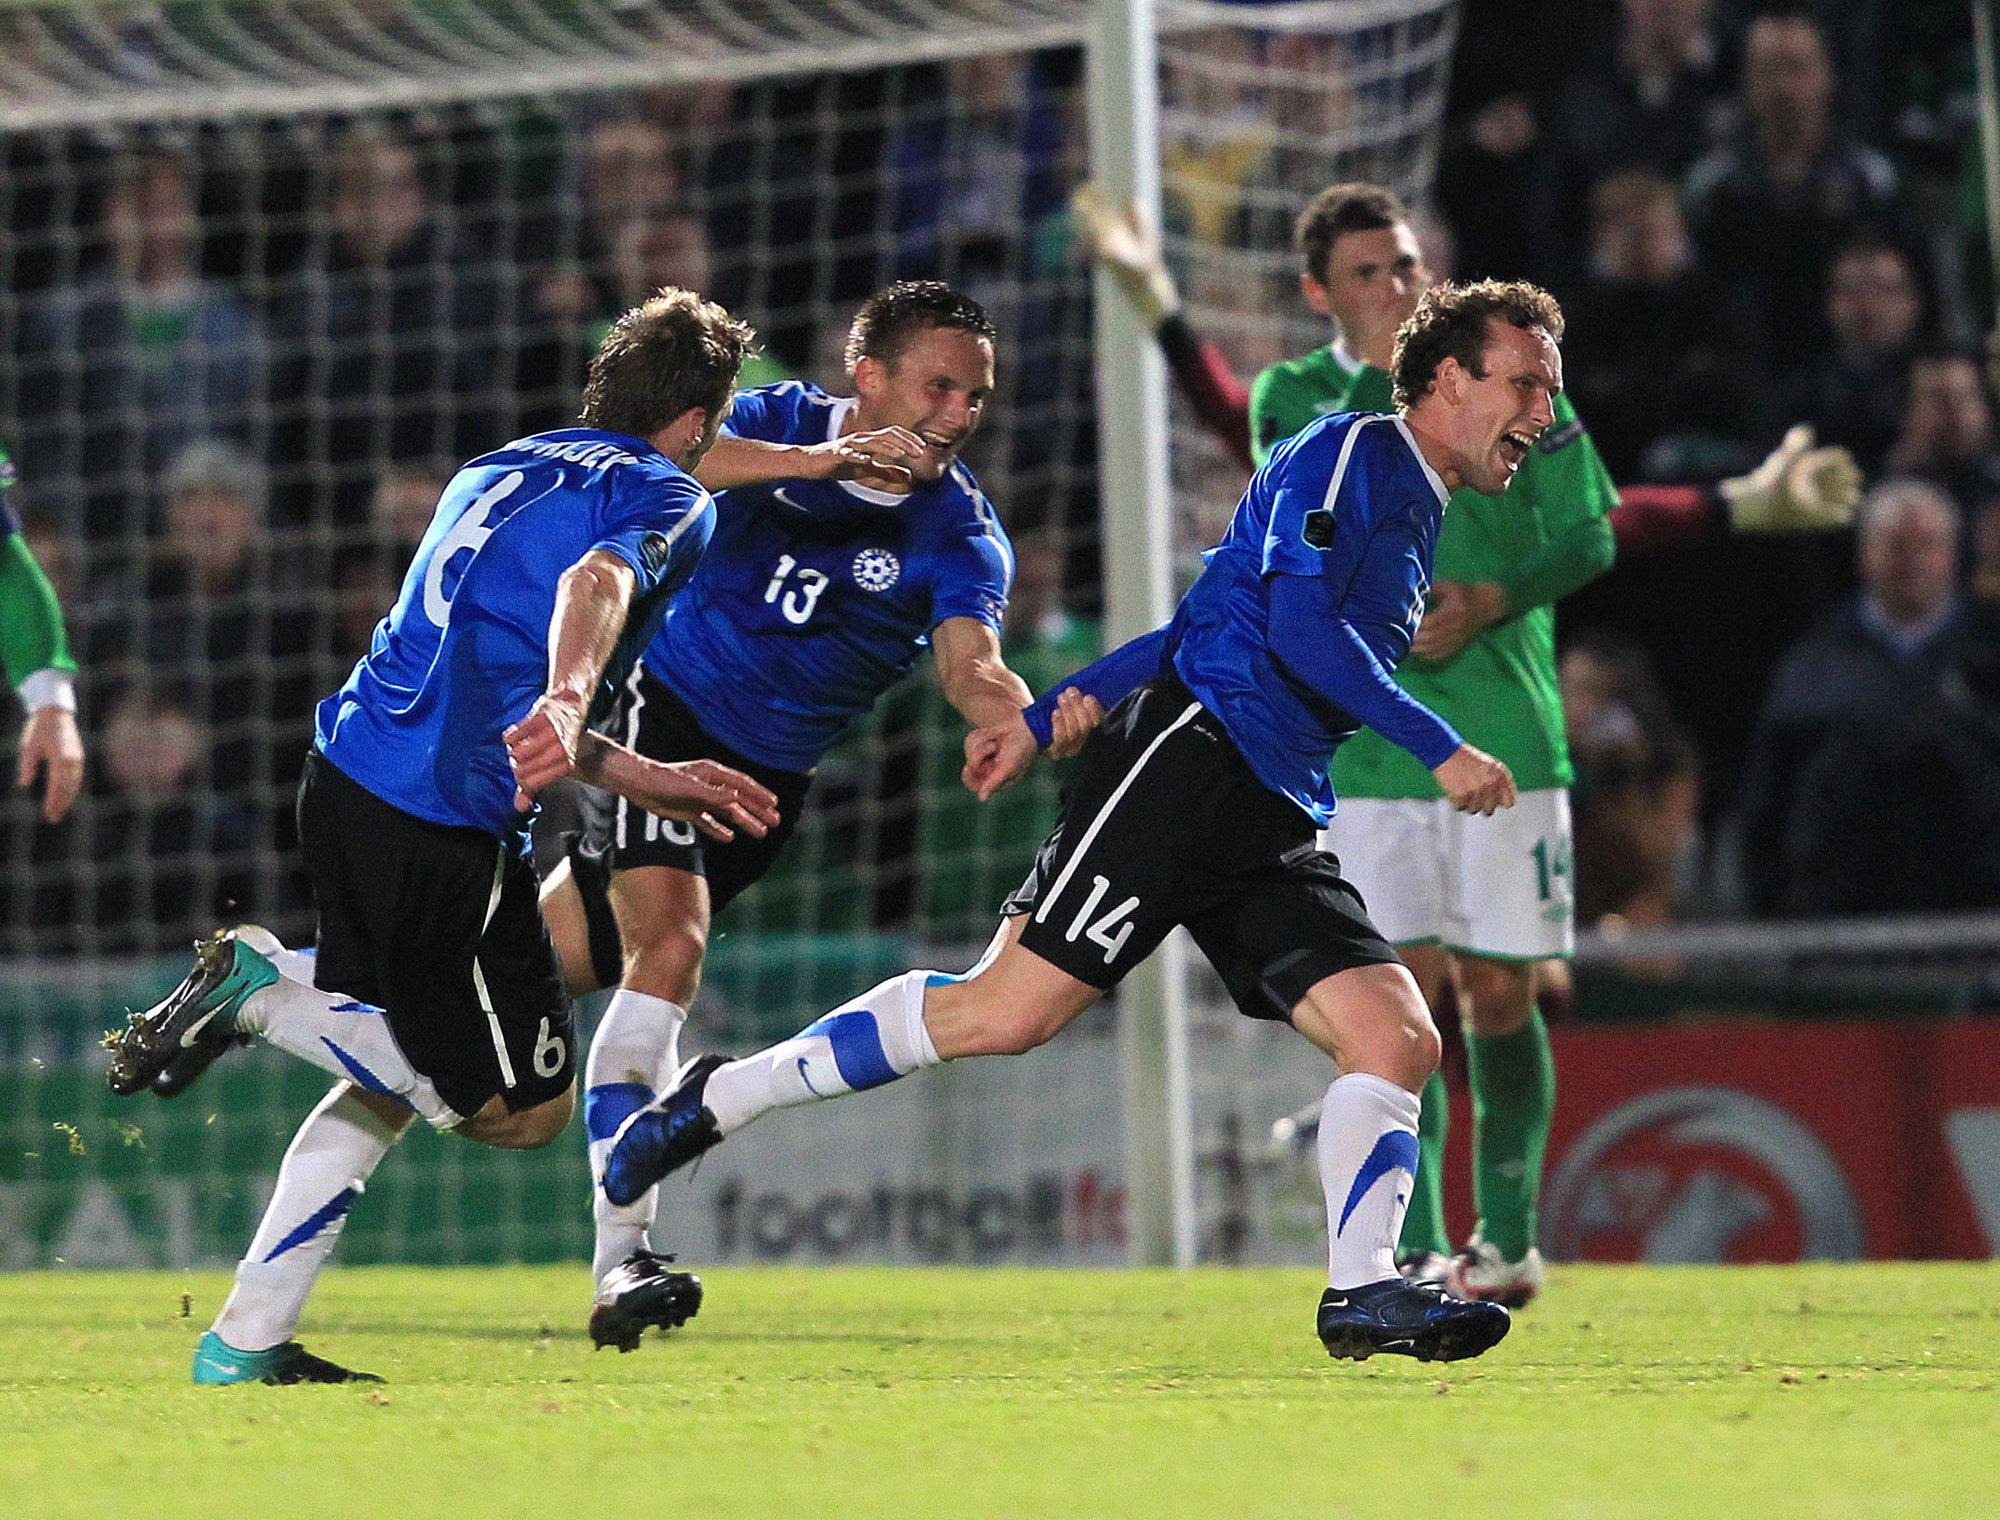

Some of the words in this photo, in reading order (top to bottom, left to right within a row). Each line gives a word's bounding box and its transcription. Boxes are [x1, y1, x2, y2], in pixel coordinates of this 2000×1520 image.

[764, 553, 830, 625] 13
[1065, 874, 1140, 964] 14
[533, 1016, 566, 1078] 6
